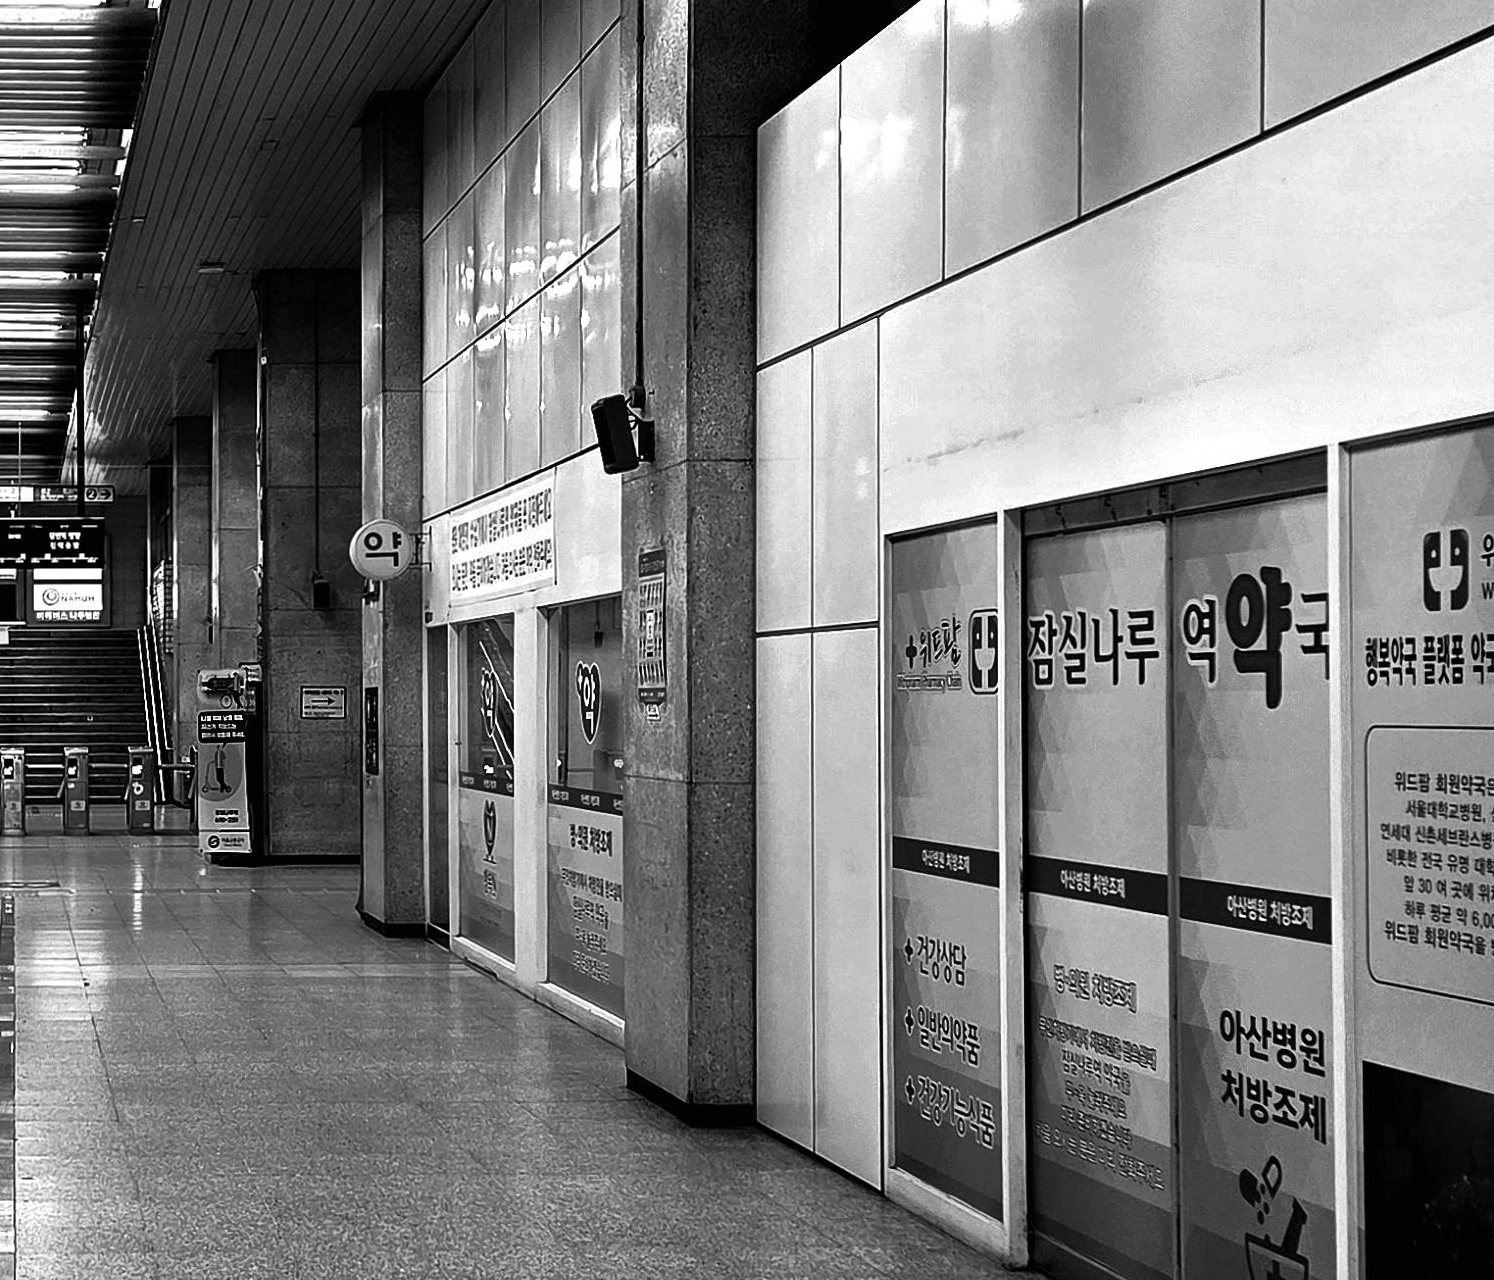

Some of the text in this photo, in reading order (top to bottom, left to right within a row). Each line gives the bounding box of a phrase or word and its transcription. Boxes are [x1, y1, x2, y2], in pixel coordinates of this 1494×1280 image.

[363, 531, 401, 567] 약
[1365, 636, 1417, 687] 행복약국
[1423, 633, 1465, 686] 플랫폼
[583, 673, 596, 735] 약
[1394, 771, 1431, 794] 위드팜
[1380, 822, 1411, 842] 연세대
[1386, 848, 1417, 869] 비롯한
[1420, 851, 1443, 872] 전국
[1447, 854, 1469, 875] 유명
[1060, 868, 1126, 899] 아산병원 처방조제
[1418, 878, 1433, 895] 30
[1437, 879, 1448, 898] 여
[1450, 881, 1474, 901] 곳에
[1226, 894, 1314, 931] 아산병원 처방조제
[1404, 900, 1426, 921] 하루
[1430, 903, 1452, 924] 평균
[1456, 907, 1469, 927] 약
[1384, 920, 1486, 956] 위드팜 회원약국을
[916, 935, 967, 987] 건강상담
[1091, 972, 1138, 1014] 처방조제
[917, 1005, 981, 1067] 일반의약품
[1219, 1008, 1327, 1079] 아산병원
[917, 1074, 996, 1150] 건강기능식품
[1220, 1068, 1328, 1146] 처방조제
